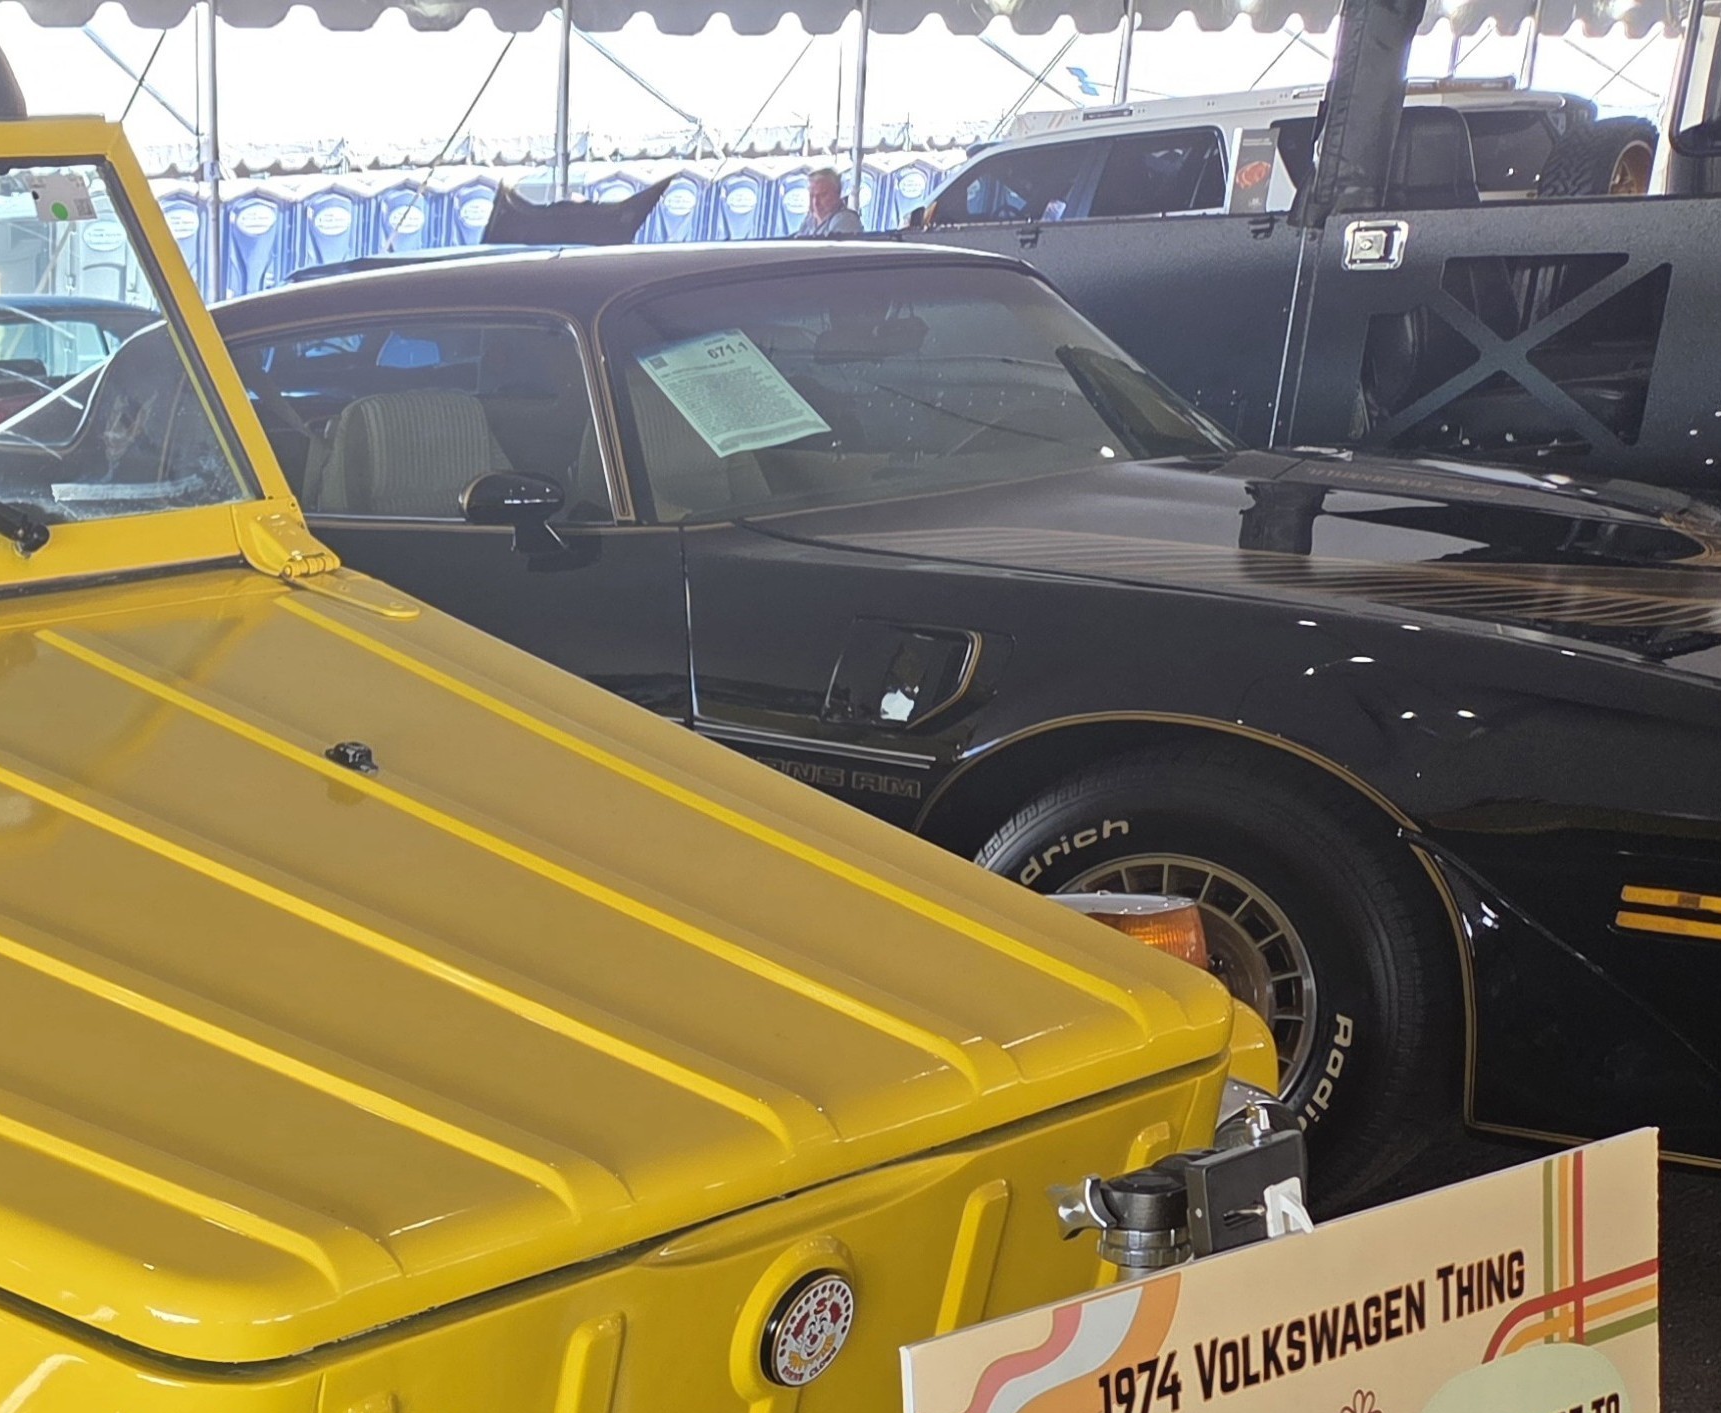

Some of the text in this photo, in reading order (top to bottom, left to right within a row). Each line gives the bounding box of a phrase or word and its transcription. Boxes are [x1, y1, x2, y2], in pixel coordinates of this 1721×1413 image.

[706, 340, 749, 361] 671.1
[851, 771, 922, 799] AM
[1019, 819, 1130, 887] drich
[1196, 1279, 1427, 1402] VOLKSWAGEN
[1436, 1249, 1526, 1325] THING
